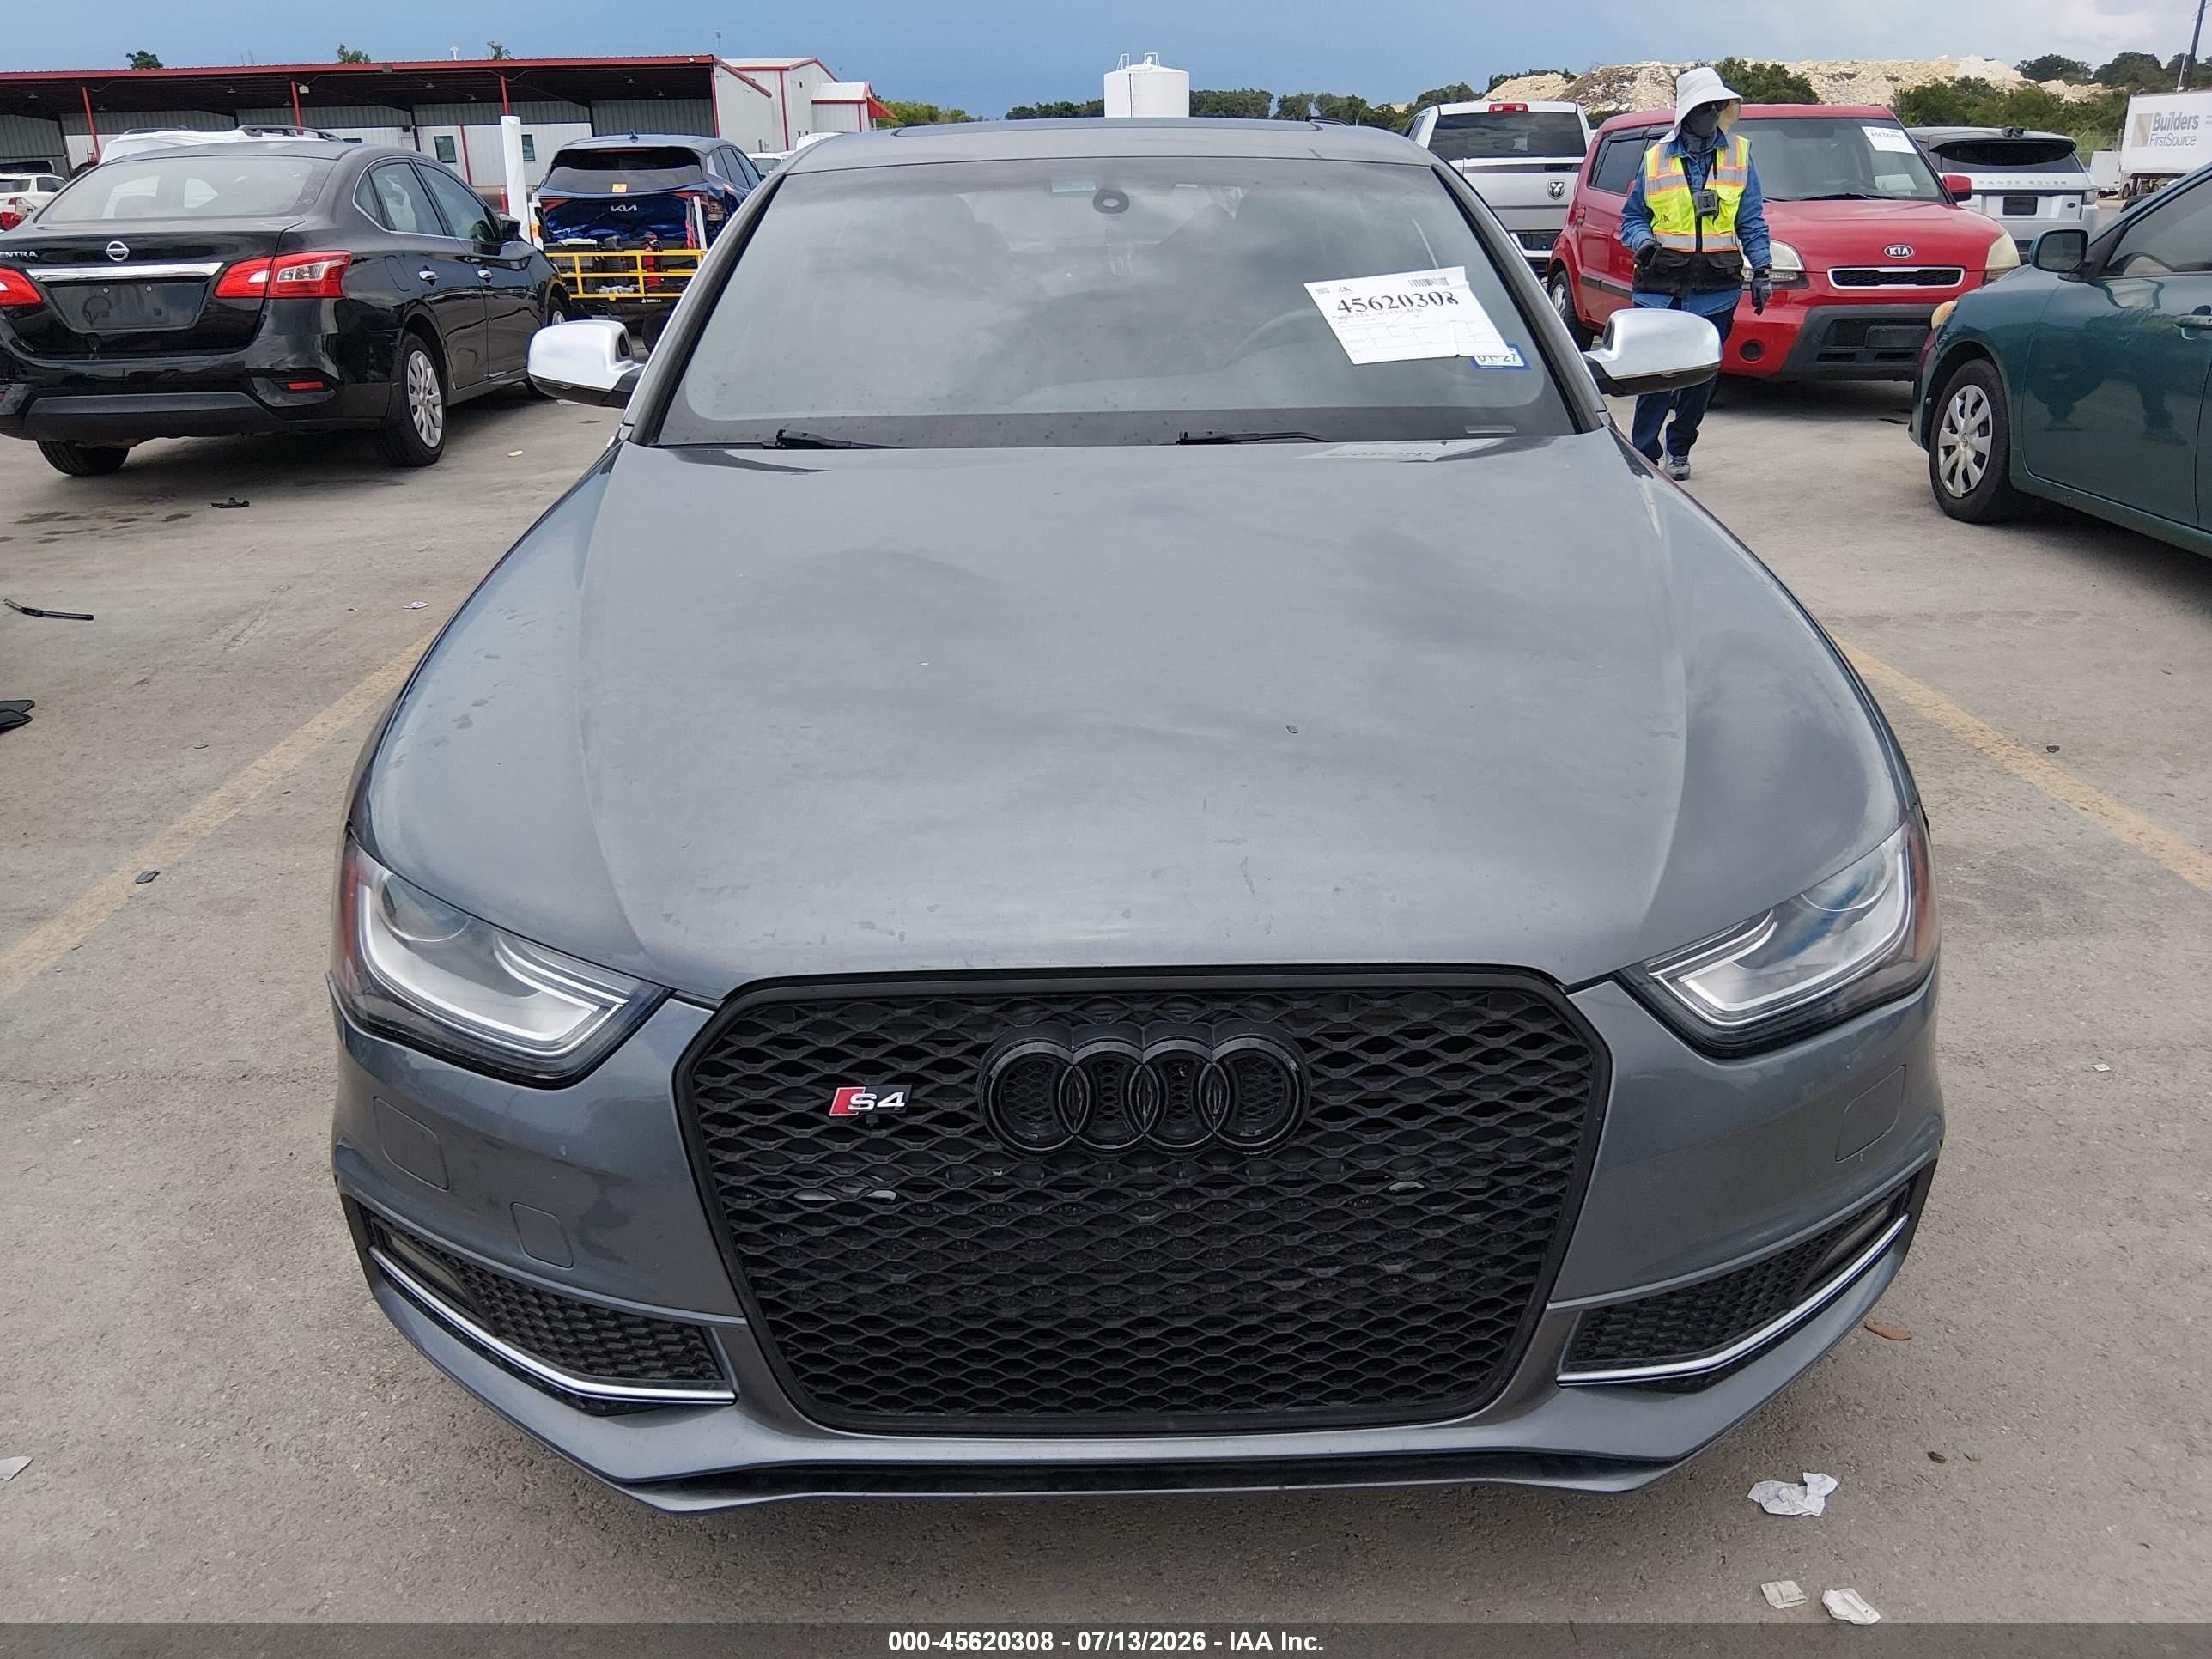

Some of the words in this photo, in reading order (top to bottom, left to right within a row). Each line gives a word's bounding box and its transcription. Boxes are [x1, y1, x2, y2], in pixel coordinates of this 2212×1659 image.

[2152, 112, 2199, 131] Builders
[2149, 133, 2197, 147] FirstSource
[1889, 246, 1910, 255] KIA
[1337, 291, 1459, 313] 45620308
[848, 1091, 906, 1110] S4
